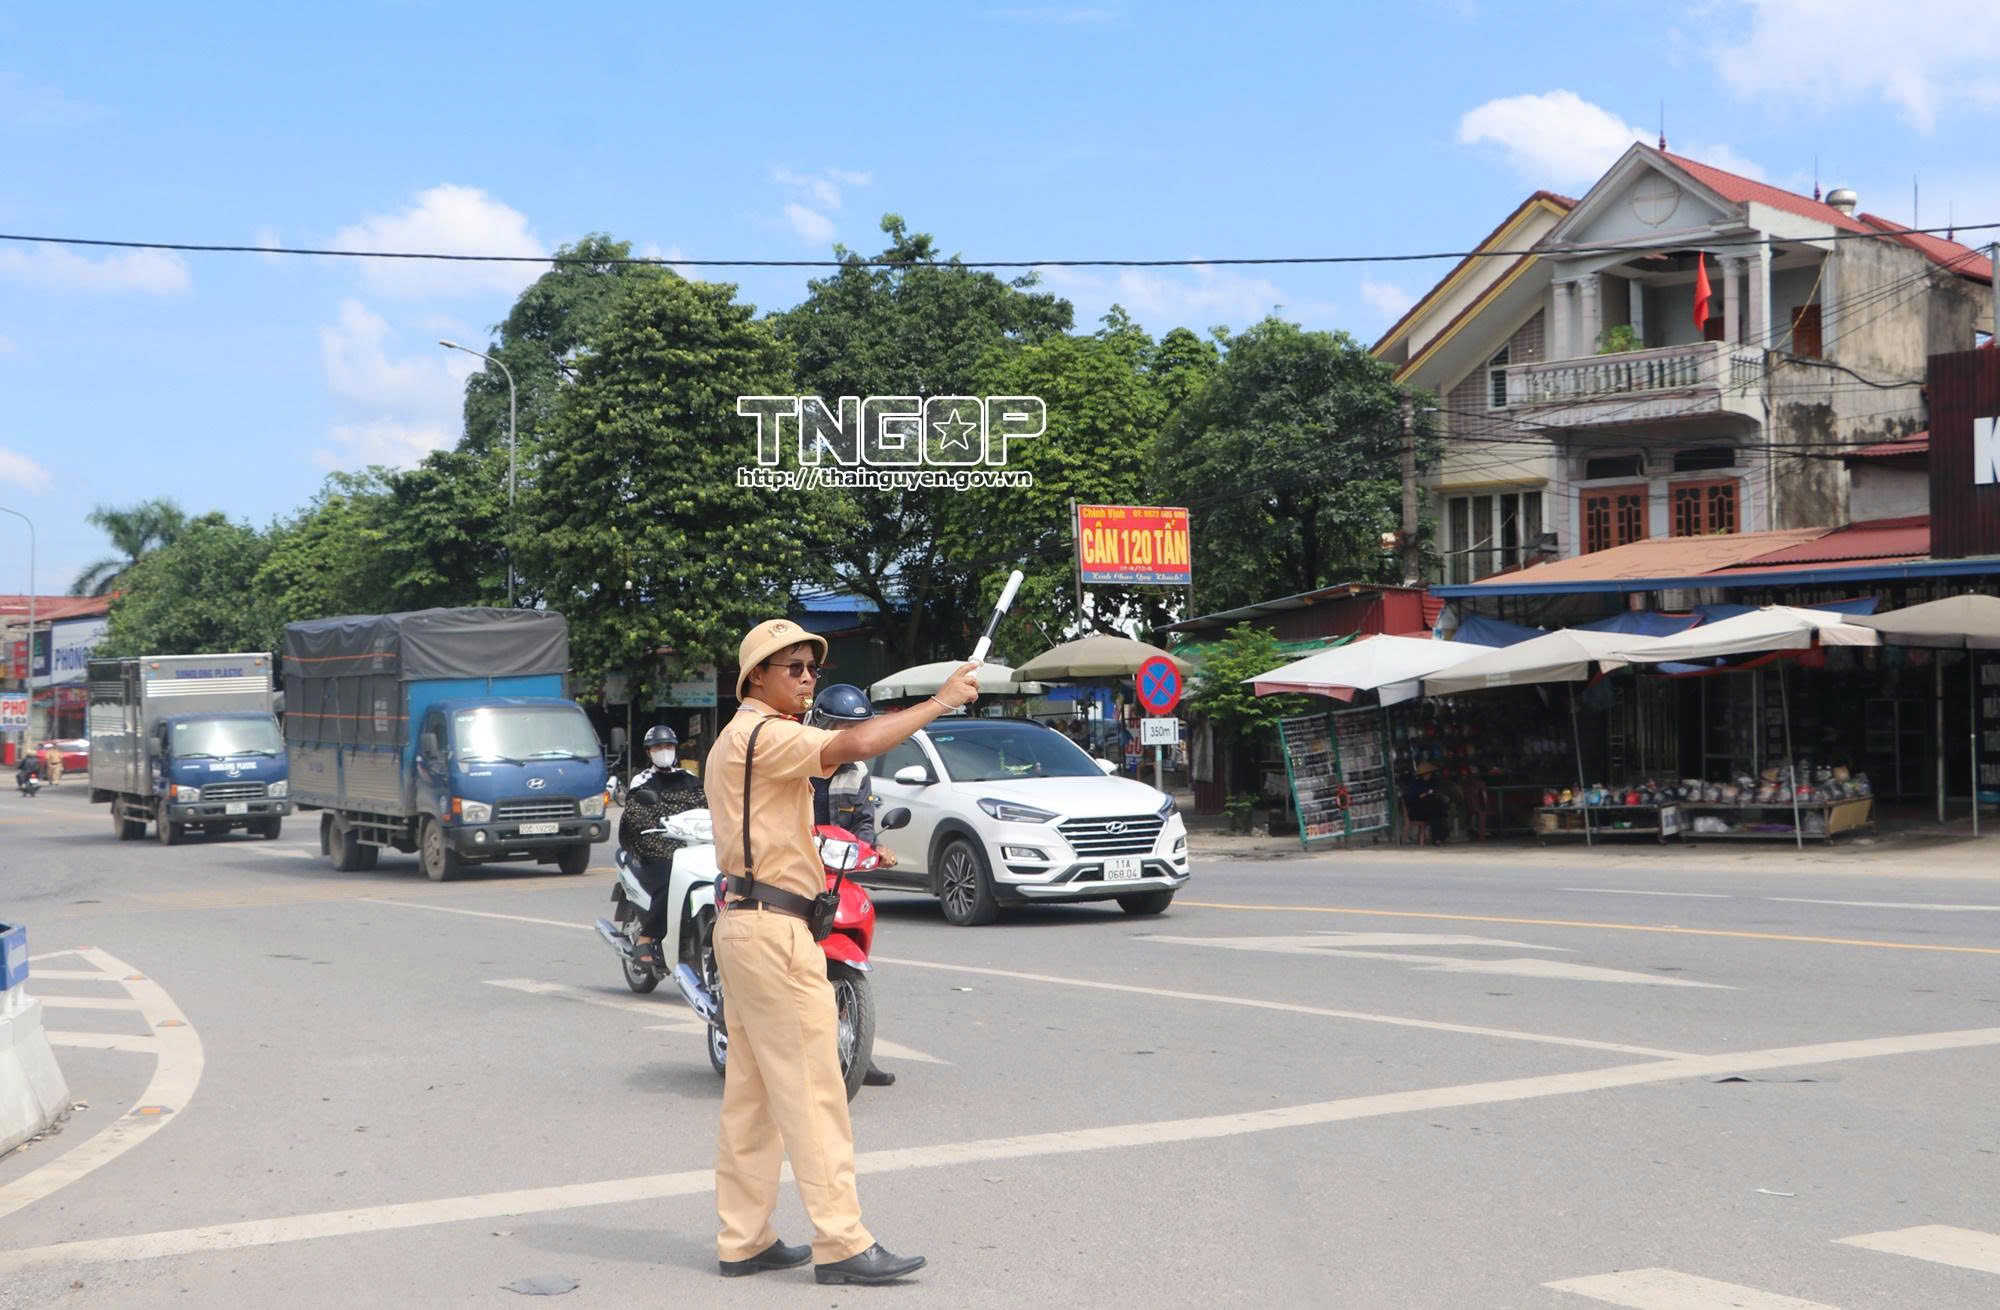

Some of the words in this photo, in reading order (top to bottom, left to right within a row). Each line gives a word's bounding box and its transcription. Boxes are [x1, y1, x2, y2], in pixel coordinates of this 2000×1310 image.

[1083, 520, 1119, 564] CÂN
[1121, 528, 1152, 565] 120
[1154, 519, 1187, 565] TẤN
[1150, 726, 1171, 737] 350m
[1115, 860, 1131, 869] 11A
[1108, 869, 1137, 879] 068.04
